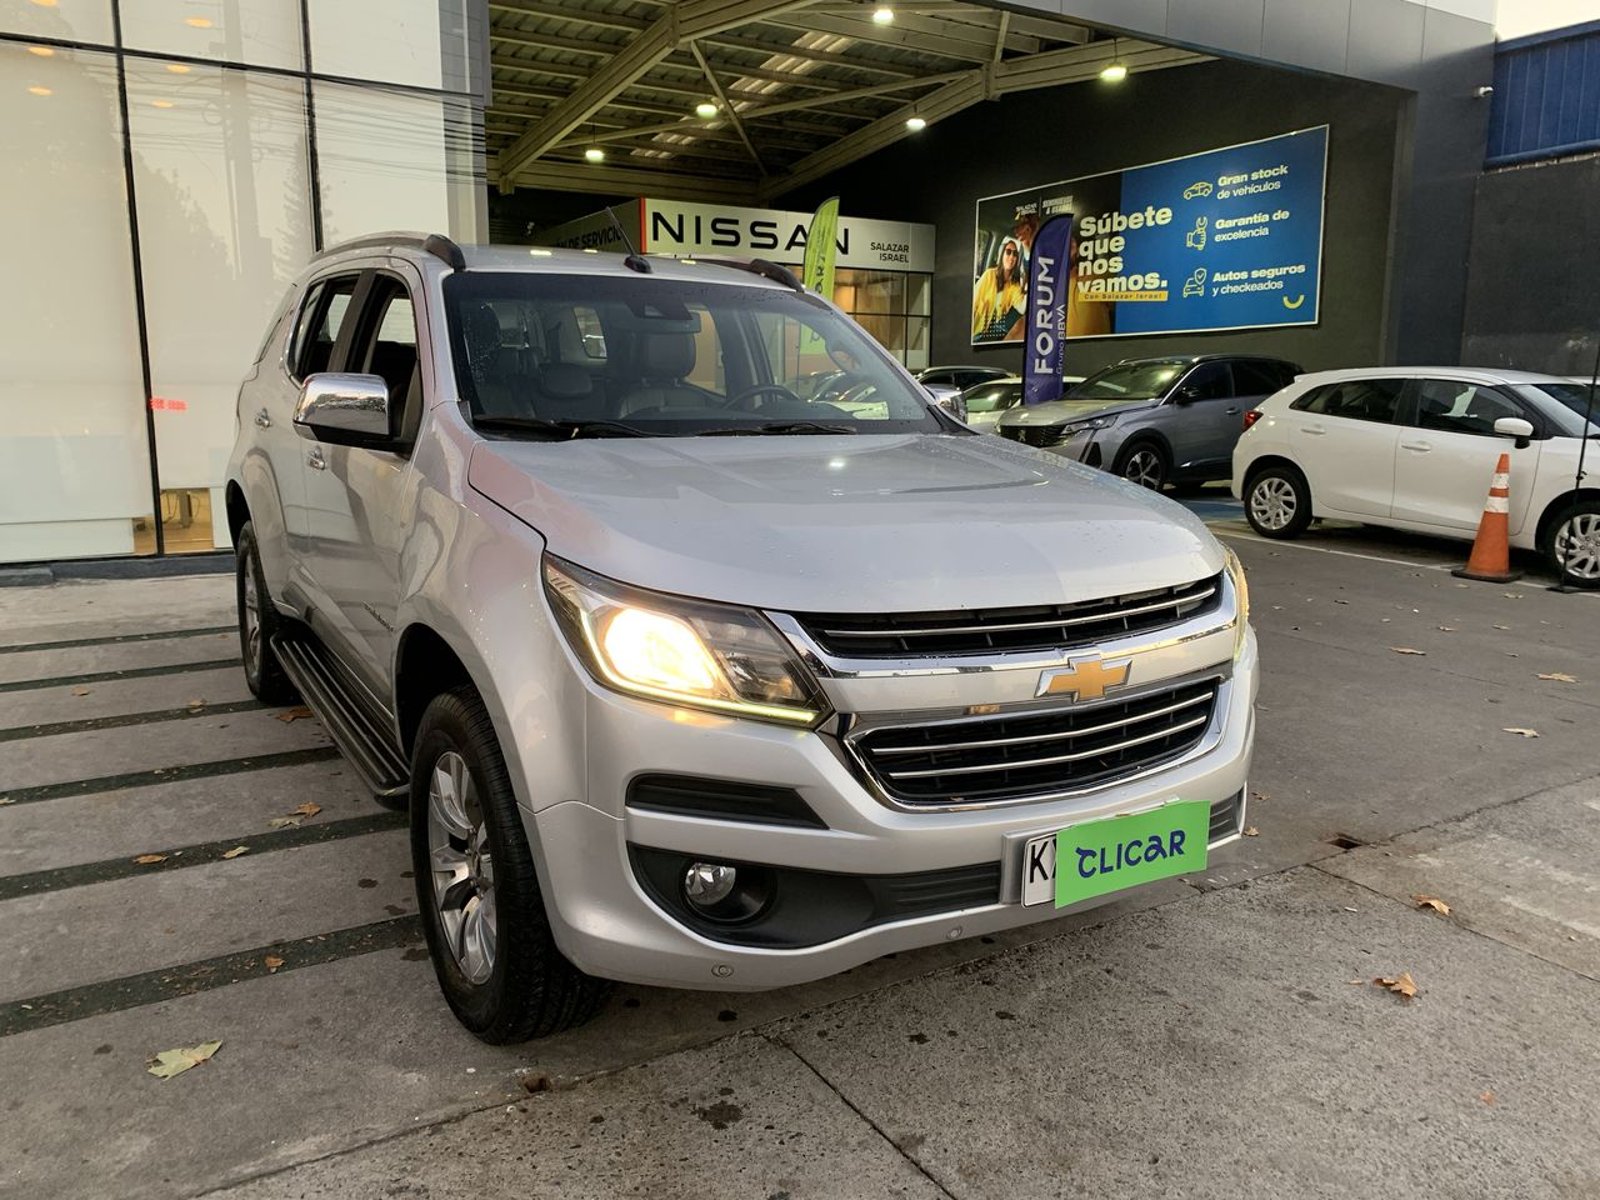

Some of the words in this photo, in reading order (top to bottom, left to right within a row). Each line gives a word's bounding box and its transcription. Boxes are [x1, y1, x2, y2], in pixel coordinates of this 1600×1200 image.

[1218, 173, 1248, 187] Gran
[1251, 164, 1289, 180] stock
[1216, 189, 1230, 200] de
[1232, 180, 1281, 197] vehículos
[1079, 205, 1173, 237] Súbete
[1215, 212, 1270, 229] Garantía
[1272, 209, 1290, 221] de
[1214, 226, 1269, 242] excelencia
[870, 241, 910, 253] SALAZAR
[1079, 236, 1125, 260] que
[879, 253, 909, 263] ISRAEL
[1078, 256, 1124, 277] nos
[1077, 272, 1168, 293] vamos.
[1212, 271, 1249, 283] Autos
[1251, 264, 1306, 280] seguros
[1212, 286, 1219, 297] y
[1220, 280, 1284, 295] checkeados
[1034, 256, 1055, 374] FORUM
[1056, 304, 1066, 340] BBVA
[1056, 341, 1065, 374] Grupo
